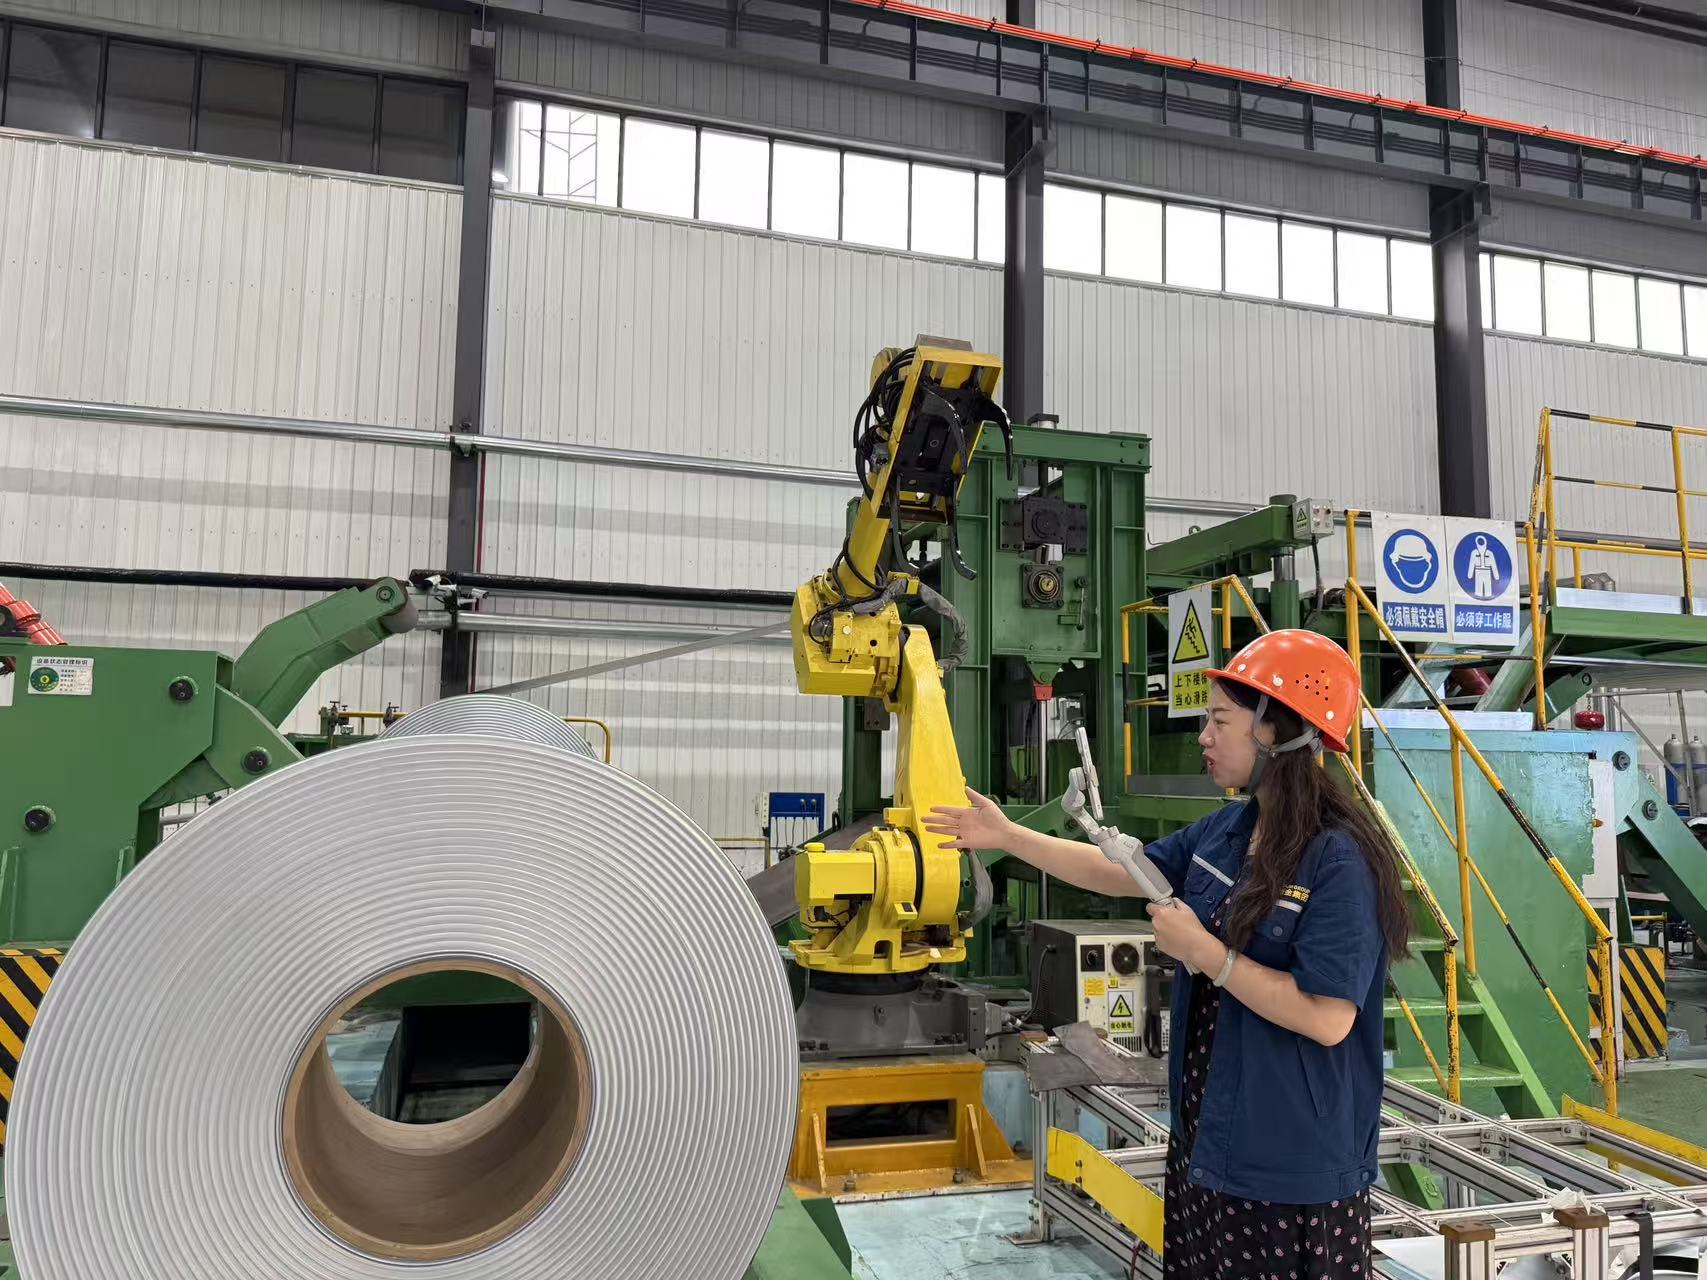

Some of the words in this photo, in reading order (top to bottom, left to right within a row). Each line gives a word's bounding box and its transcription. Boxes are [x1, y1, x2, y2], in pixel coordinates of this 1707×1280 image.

[1385, 605, 1446, 629] 必须佩戴安全帽
[1456, 611, 1513, 629] 必须穿工作服
